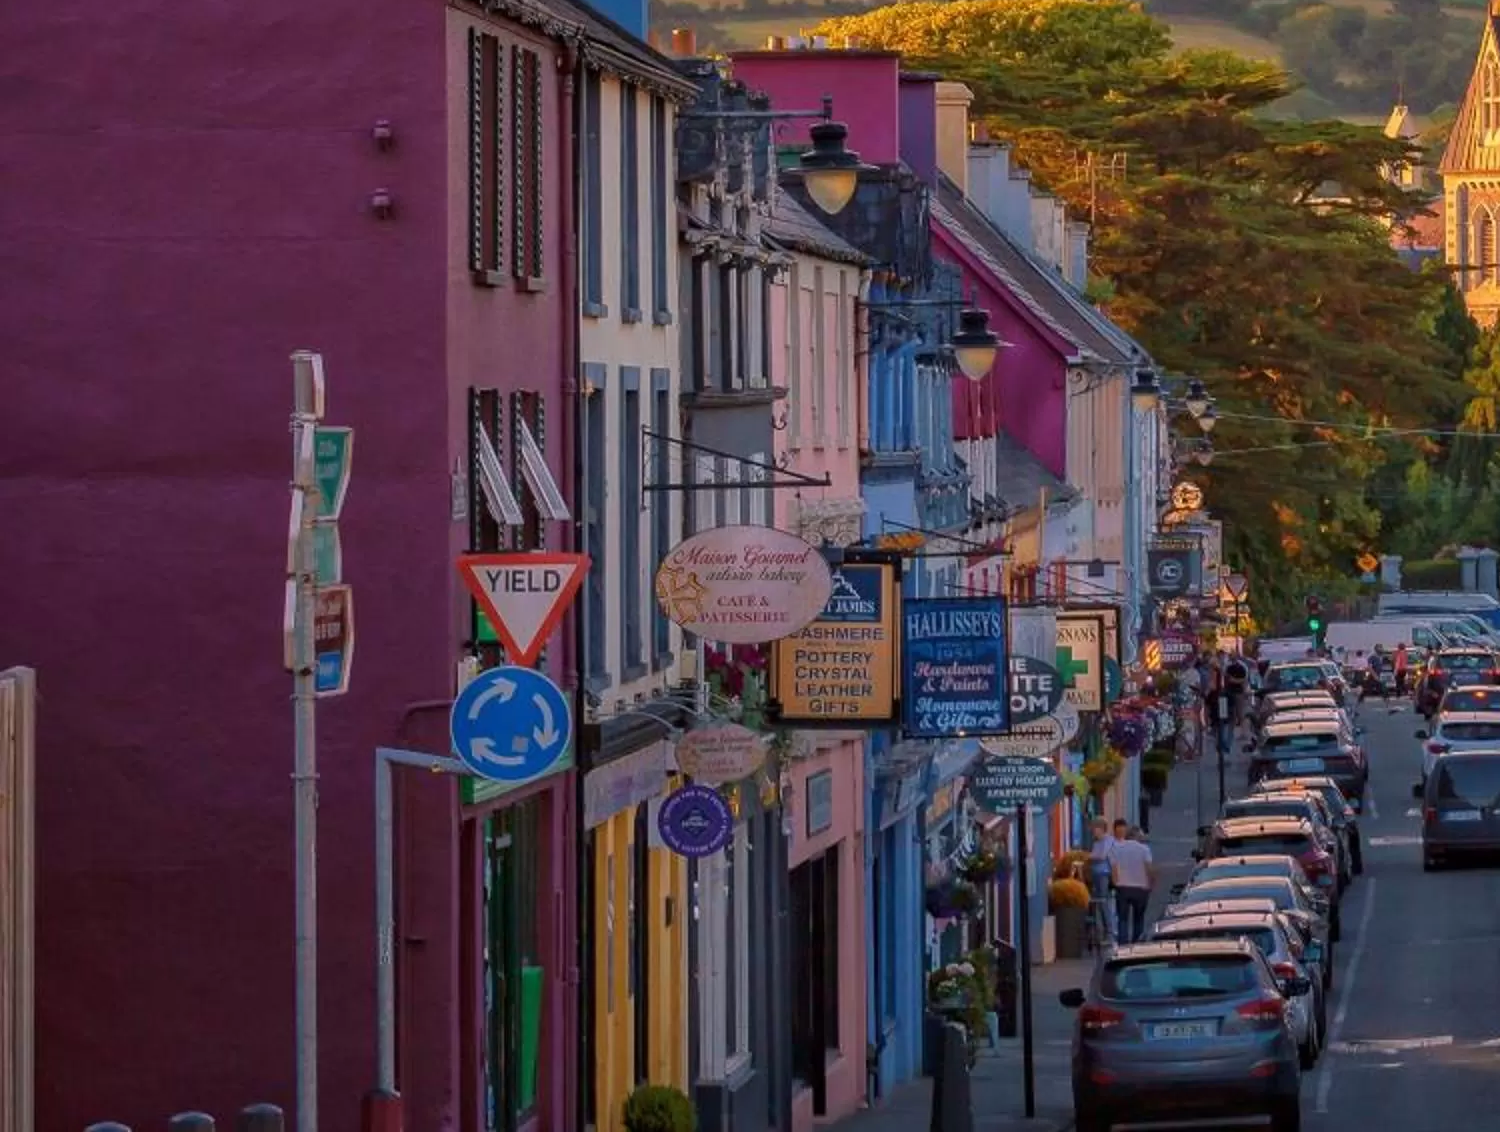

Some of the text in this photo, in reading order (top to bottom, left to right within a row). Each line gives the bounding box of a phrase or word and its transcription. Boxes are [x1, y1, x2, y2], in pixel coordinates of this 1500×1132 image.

[486, 569, 561, 593] YIELD
[795, 649, 874, 664] POTTERY
[795, 667, 872, 680] CRYSTAL
[795, 683, 873, 697] LEATHER
[1013, 674, 1053, 693] ITE
[809, 699, 859, 713] GIFTS
[1011, 695, 1049, 713] OM
